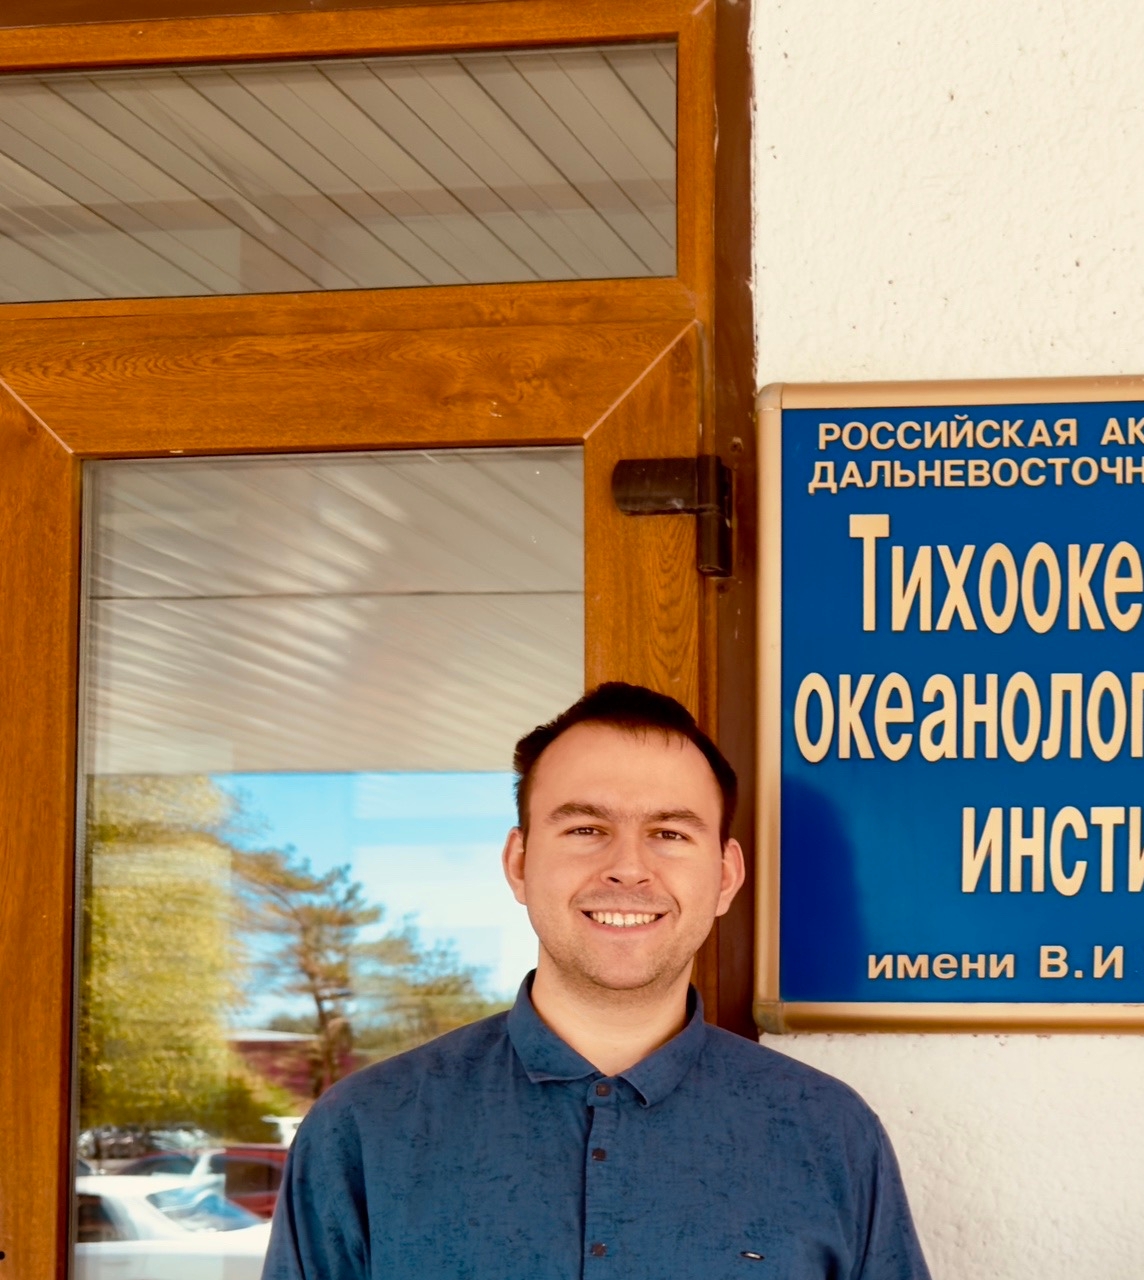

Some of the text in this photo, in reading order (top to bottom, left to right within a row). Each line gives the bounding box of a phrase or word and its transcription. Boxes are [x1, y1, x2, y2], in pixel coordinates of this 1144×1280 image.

[818, 414, 1078, 450] РОССИЙСКАЯ
[868, 953, 1016, 979] имени
[1039, 945, 1124, 979] В.И
